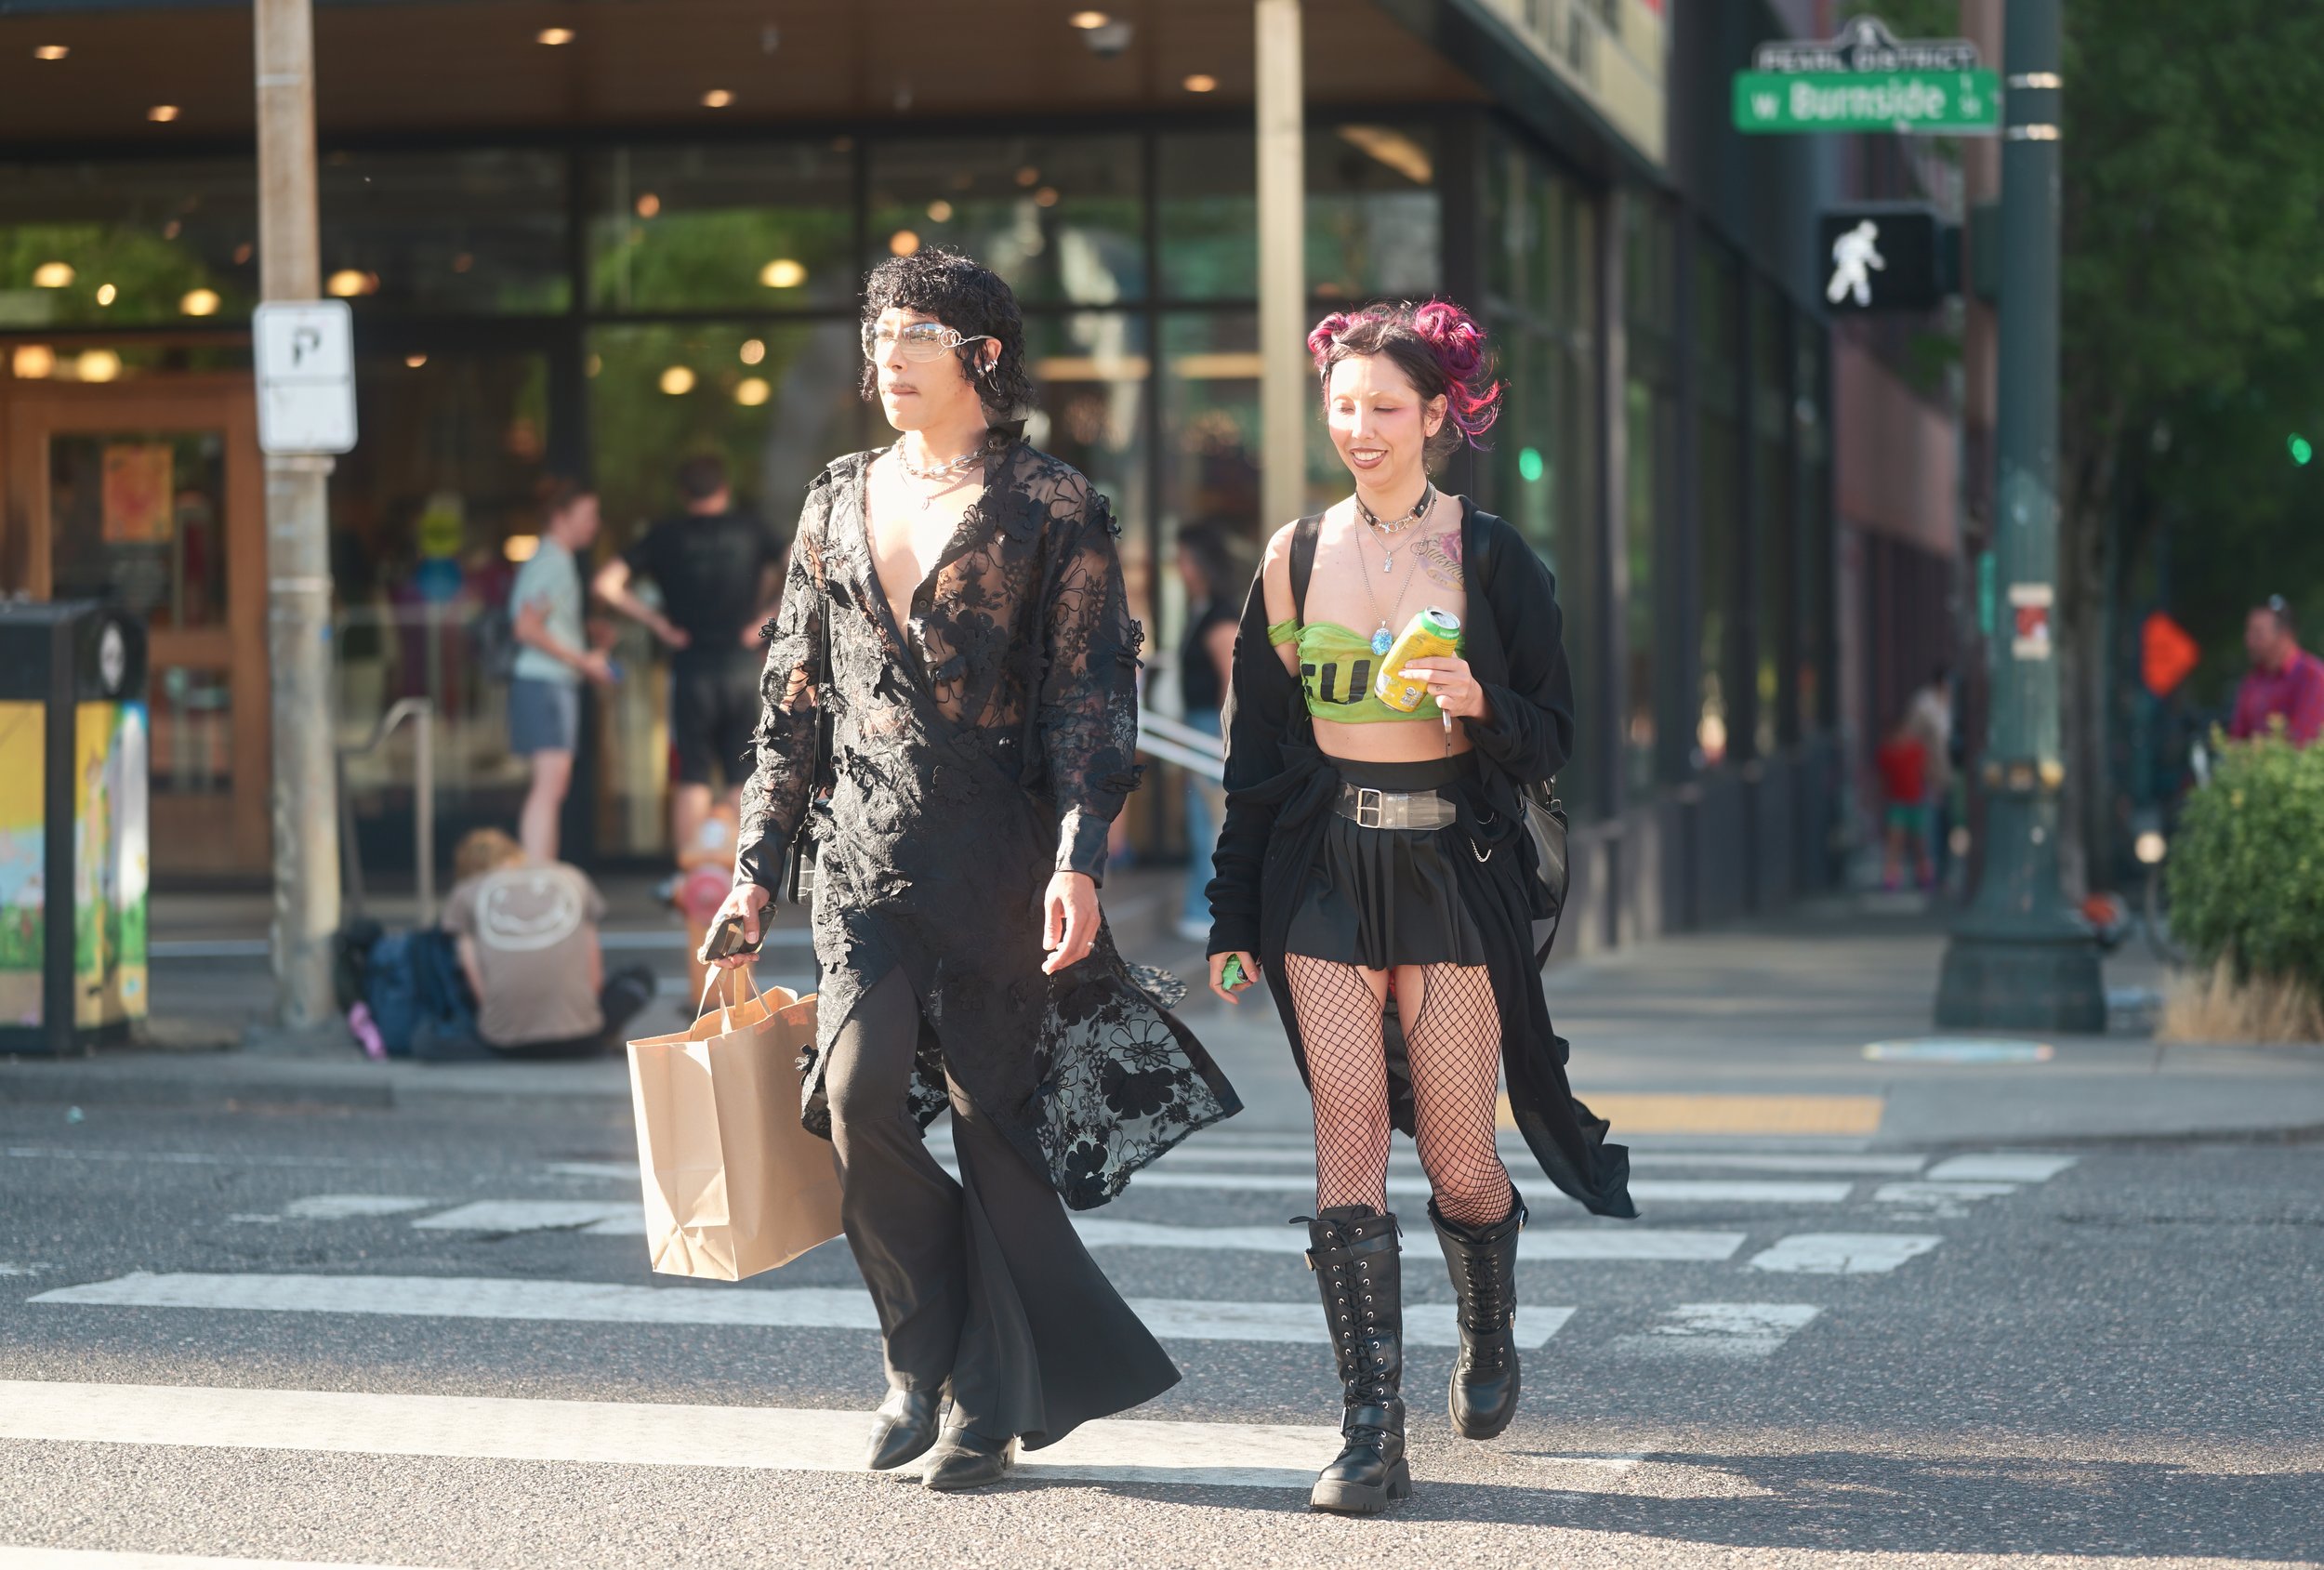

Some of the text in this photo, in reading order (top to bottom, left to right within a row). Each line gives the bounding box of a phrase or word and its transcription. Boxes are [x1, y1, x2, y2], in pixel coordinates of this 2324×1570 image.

[1758, 46, 1974, 73] PEARL DISTRICT
[1751, 90, 1781, 120] W
[1789, 76, 1947, 121] Burnside
